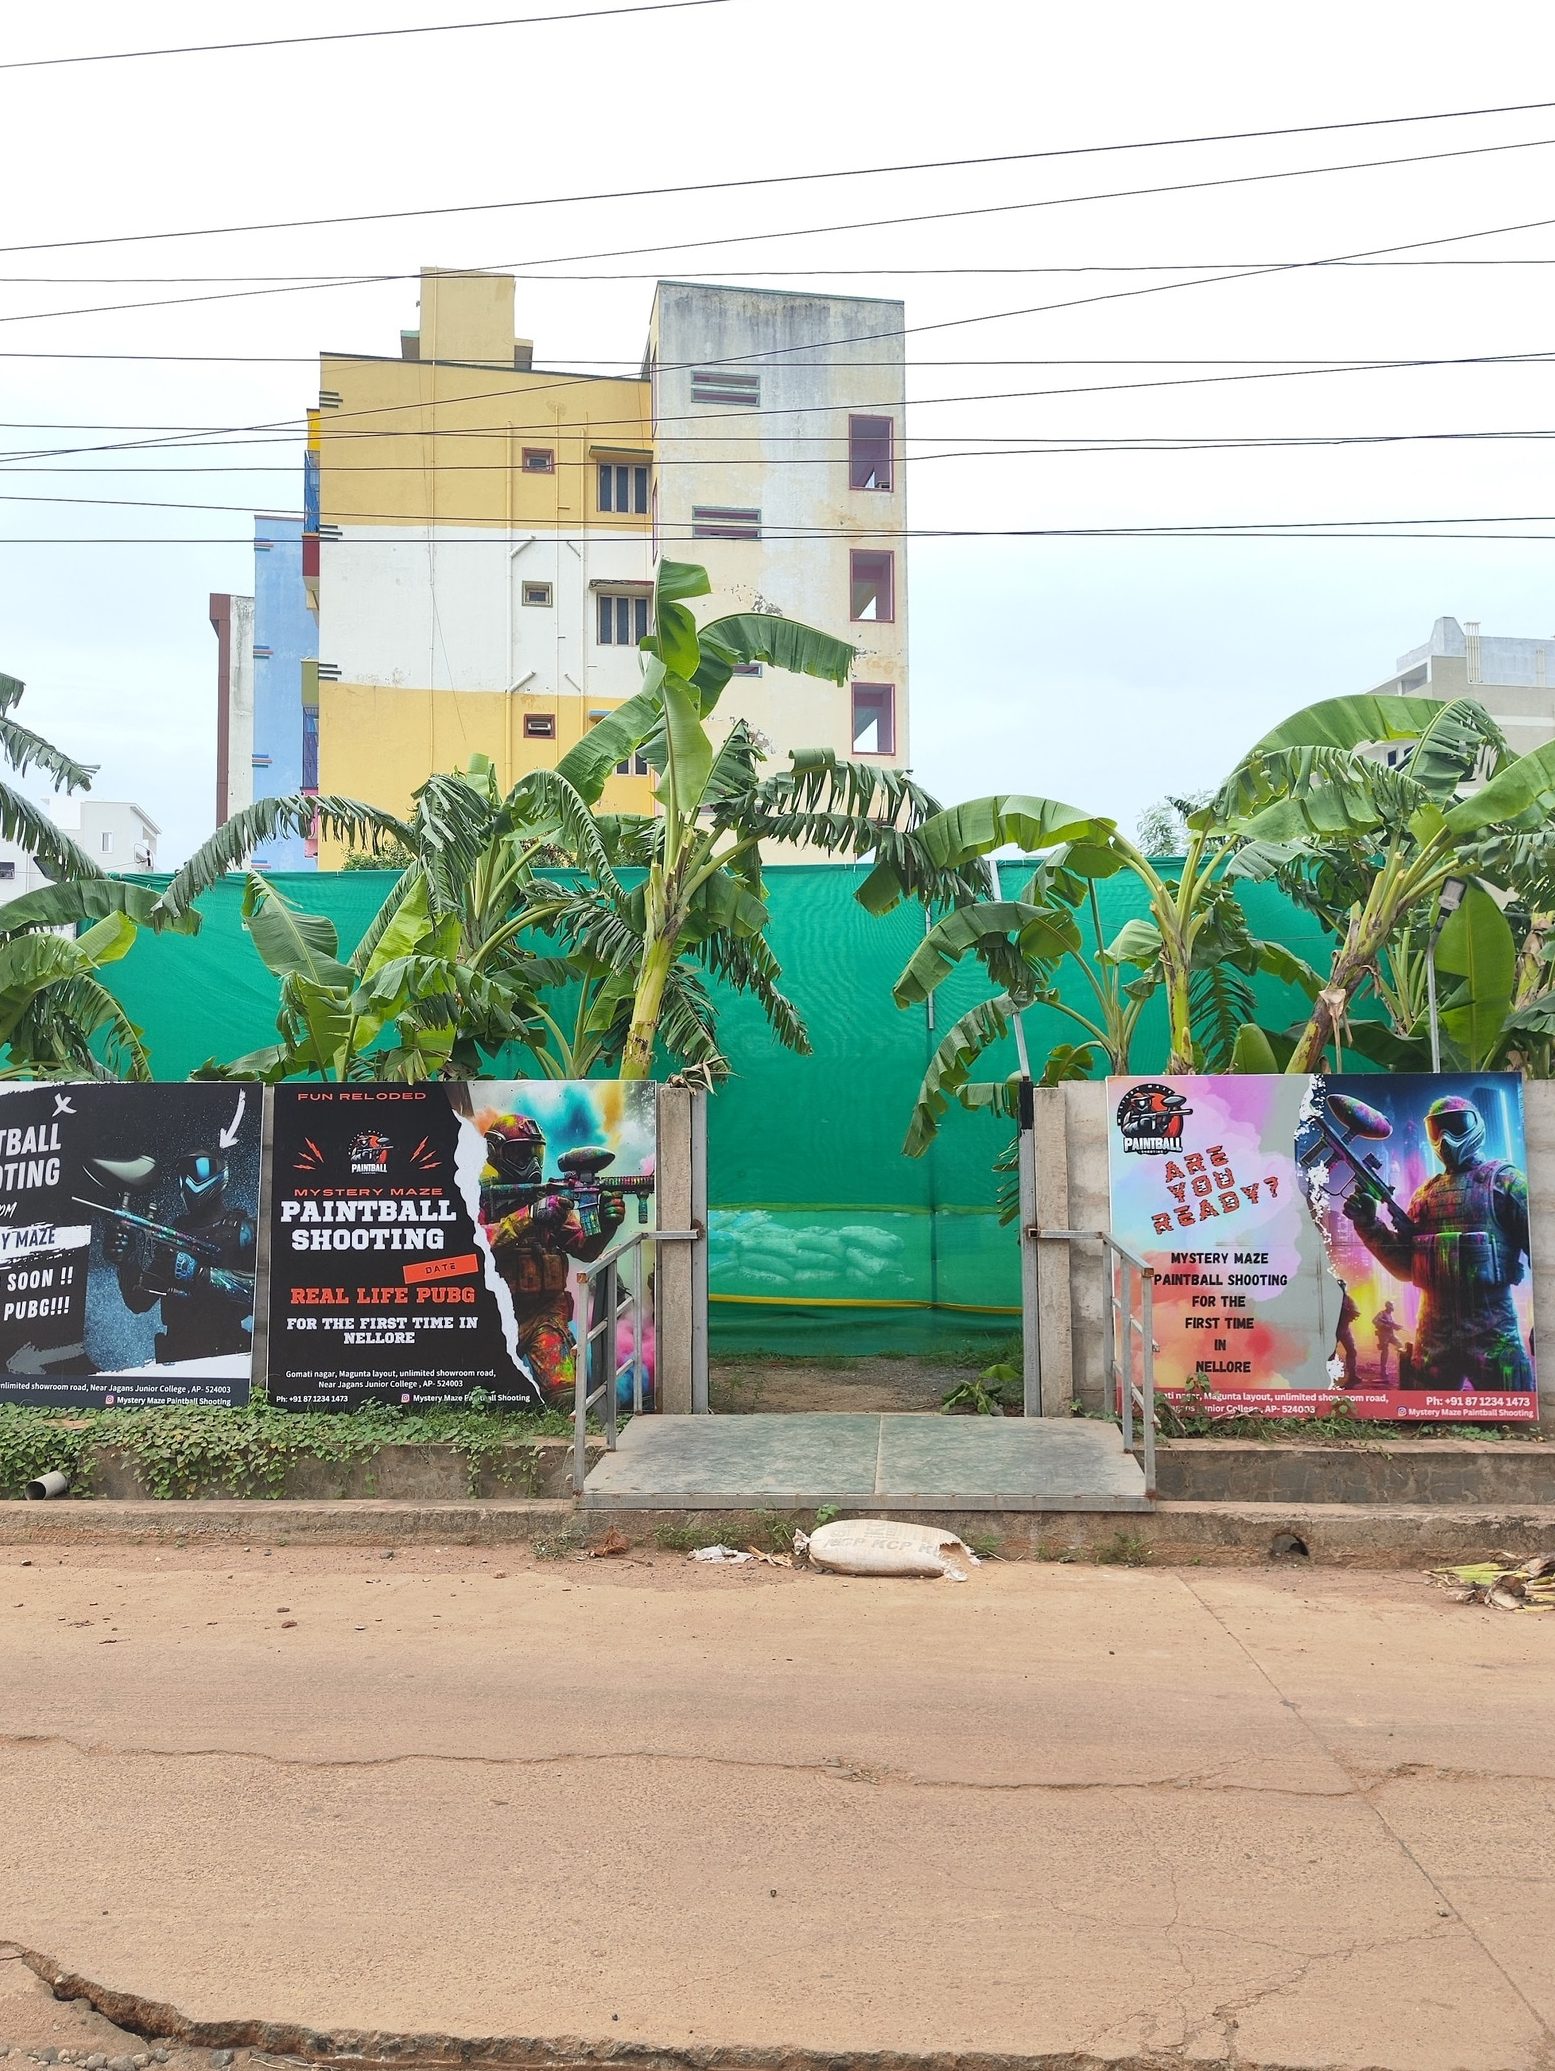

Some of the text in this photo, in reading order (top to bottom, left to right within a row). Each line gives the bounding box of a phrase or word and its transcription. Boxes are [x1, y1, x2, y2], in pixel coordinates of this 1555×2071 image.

[340, 1092, 427, 1100] RELODED
[1124, 1137, 1183, 1152] PAINTBALL
[351, 1163, 388, 1173] PAINTBALL
[1165, 1145, 1229, 1183] ARE
[1167, 1167, 1236, 1203] YOU
[294, 1188, 443, 1197] MYSTERY MAZE
[280, 1200, 457, 1223] PAINTBALL
[1151, 1176, 1279, 1235] READY?
[15, 1229, 55, 1249] MAZE
[291, 1228, 444, 1251] SHOOTING
[1171, 1253, 1269, 1264] MYSTERY MAZE
[425, 1262, 457, 1275] DATE
[7, 1268, 54, 1292] SOON
[1154, 1274, 1288, 1286] PAINTBALL SHOOTING
[290, 1286, 475, 1304] REAL LIFE PUBG
[1192, 1296, 1246, 1307] FOR THE
[3, 1295, 70, 1321] PUBG!!!
[286, 1316, 479, 1330] FOR THE FIRST TIME IN
[1185, 1318, 1254, 1329] FIRST TIME
[343, 1332, 415, 1345] NELLORE
[1214, 1339, 1226, 1351] IN
[1196, 1361, 1251, 1373] NELLORE
[285, 1369, 496, 1379] Gomati nagar, Magunta layout, unlimited showroom road,
[31, 1382, 69, 1391] showroom
[69, 1384, 89, 1392] road,
[90, 1384, 107, 1392] Near
[108, 1385, 133, 1393] Jagans
[159, 1385, 186, 1394] College
[205, 1386, 231, 1394] 524003
[337, 1381, 363, 1390] Jagans
[365, 1380, 388, 1388] Junior
[389, 1380, 418, 1389] College
[423, 1380, 435, 1388] AP-
[117, 1397, 146, 1406] Mystery
[199, 1398, 231, 1406] Shooting
[413, 1395, 441, 1403] Mystery
[497, 1394, 531, 1403] Shooting
[1203, 1392, 1241, 1402] Magunta
[1242, 1392, 1273, 1402] layout,
[1274, 1393, 1317, 1402] unlimited
[1318, 1393, 1364, 1402] showoom
[1365, 1394, 1389, 1404] road,
[1426, 1396, 1530, 1407] Ph: +91 87 1234 1473
[1264, 1404, 1280, 1413] AP-
[1408, 1408, 1534, 1418] Mystery Maze Paintball Shooting
[871, 1538, 913, 1551] KCP
